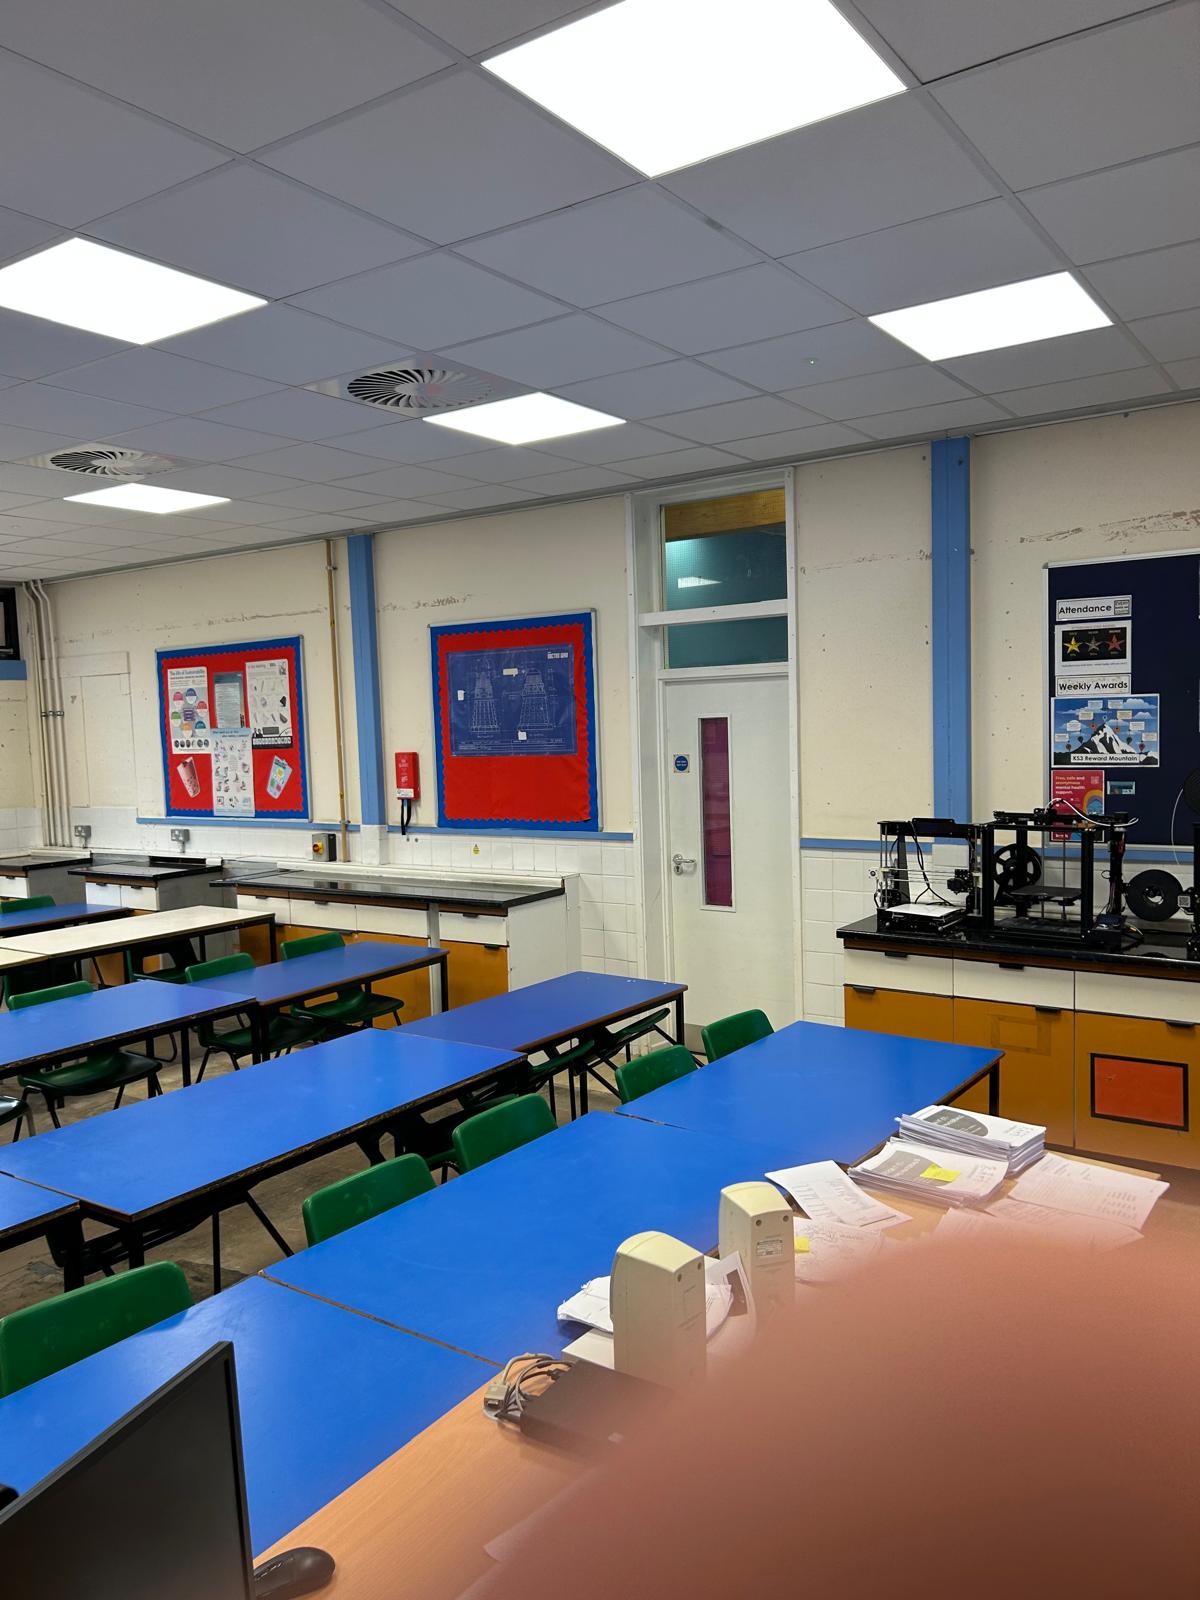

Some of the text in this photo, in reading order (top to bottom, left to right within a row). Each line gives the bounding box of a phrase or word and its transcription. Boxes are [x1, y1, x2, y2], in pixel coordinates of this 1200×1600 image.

[1058, 605, 1112, 614] Attendance
[1059, 681, 1128, 692] Weekly Awards
